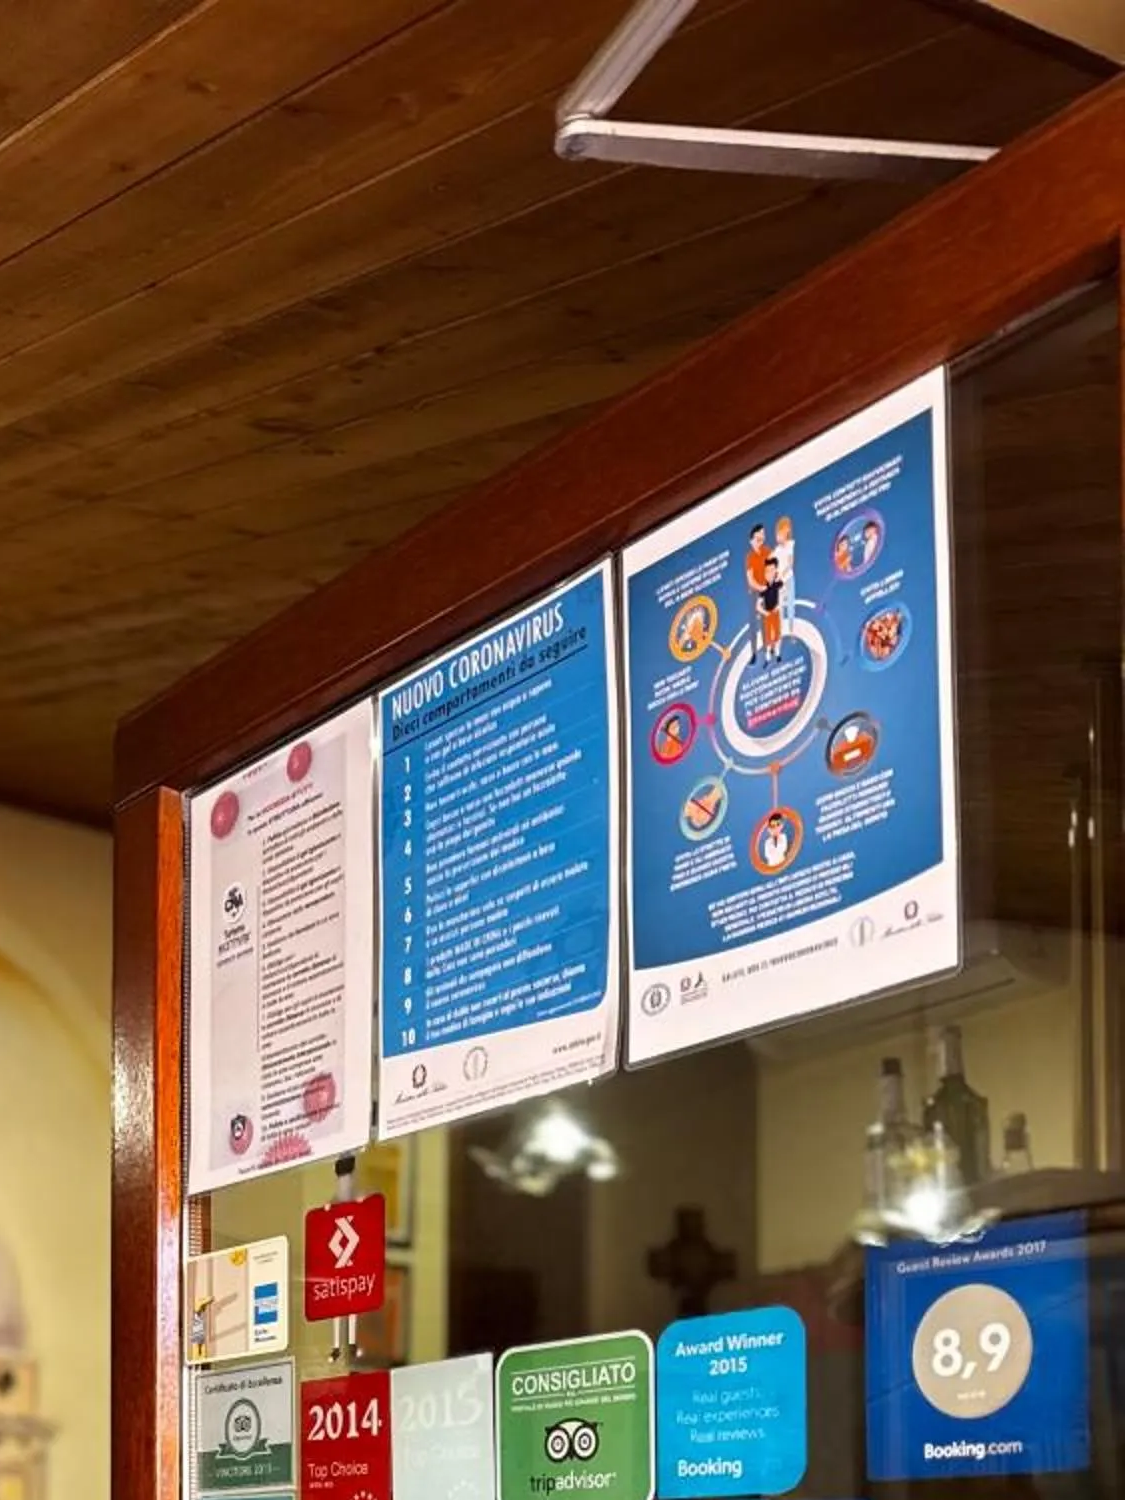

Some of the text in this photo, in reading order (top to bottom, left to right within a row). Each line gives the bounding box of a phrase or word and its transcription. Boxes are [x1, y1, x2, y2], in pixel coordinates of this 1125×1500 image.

[392, 603, 564, 720] NUOVO CORONAVIRUS
[392, 717, 420, 742] Dieci
[422, 664, 516, 731] comportamenti
[404, 756, 411, 773] 1
[404, 784, 412, 803] 2
[403, 808, 412, 828] 3
[404, 839, 412, 856] 4
[404, 876, 412, 896] 5
[404, 905, 412, 924] 6
[404, 935, 412, 955] 7
[404, 967, 412, 986] 8
[404, 997, 412, 1016] 9
[402, 1027, 415, 1047] 10
[931, 1254, 970, 1269] Review
[974, 1246, 1014, 1263] Awards
[1017, 1239, 1046, 1257] 2017
[313, 1272, 376, 1302] satispay
[675, 1332, 784, 1357] Award Winner
[932, 1322, 1011, 1380] 8,9
[709, 1356, 748, 1376] 2015
[512, 1361, 636, 1396] CONSIGLIATO
[399, 1381, 484, 1432] 2015
[307, 1397, 382, 1441] 2014
[924, 1439, 1022, 1460] Booking.com
[307, 1460, 368, 1480] Top Choice
[678, 1456, 743, 1479] Booking
[530, 1470, 612, 1497] tripadvisor
